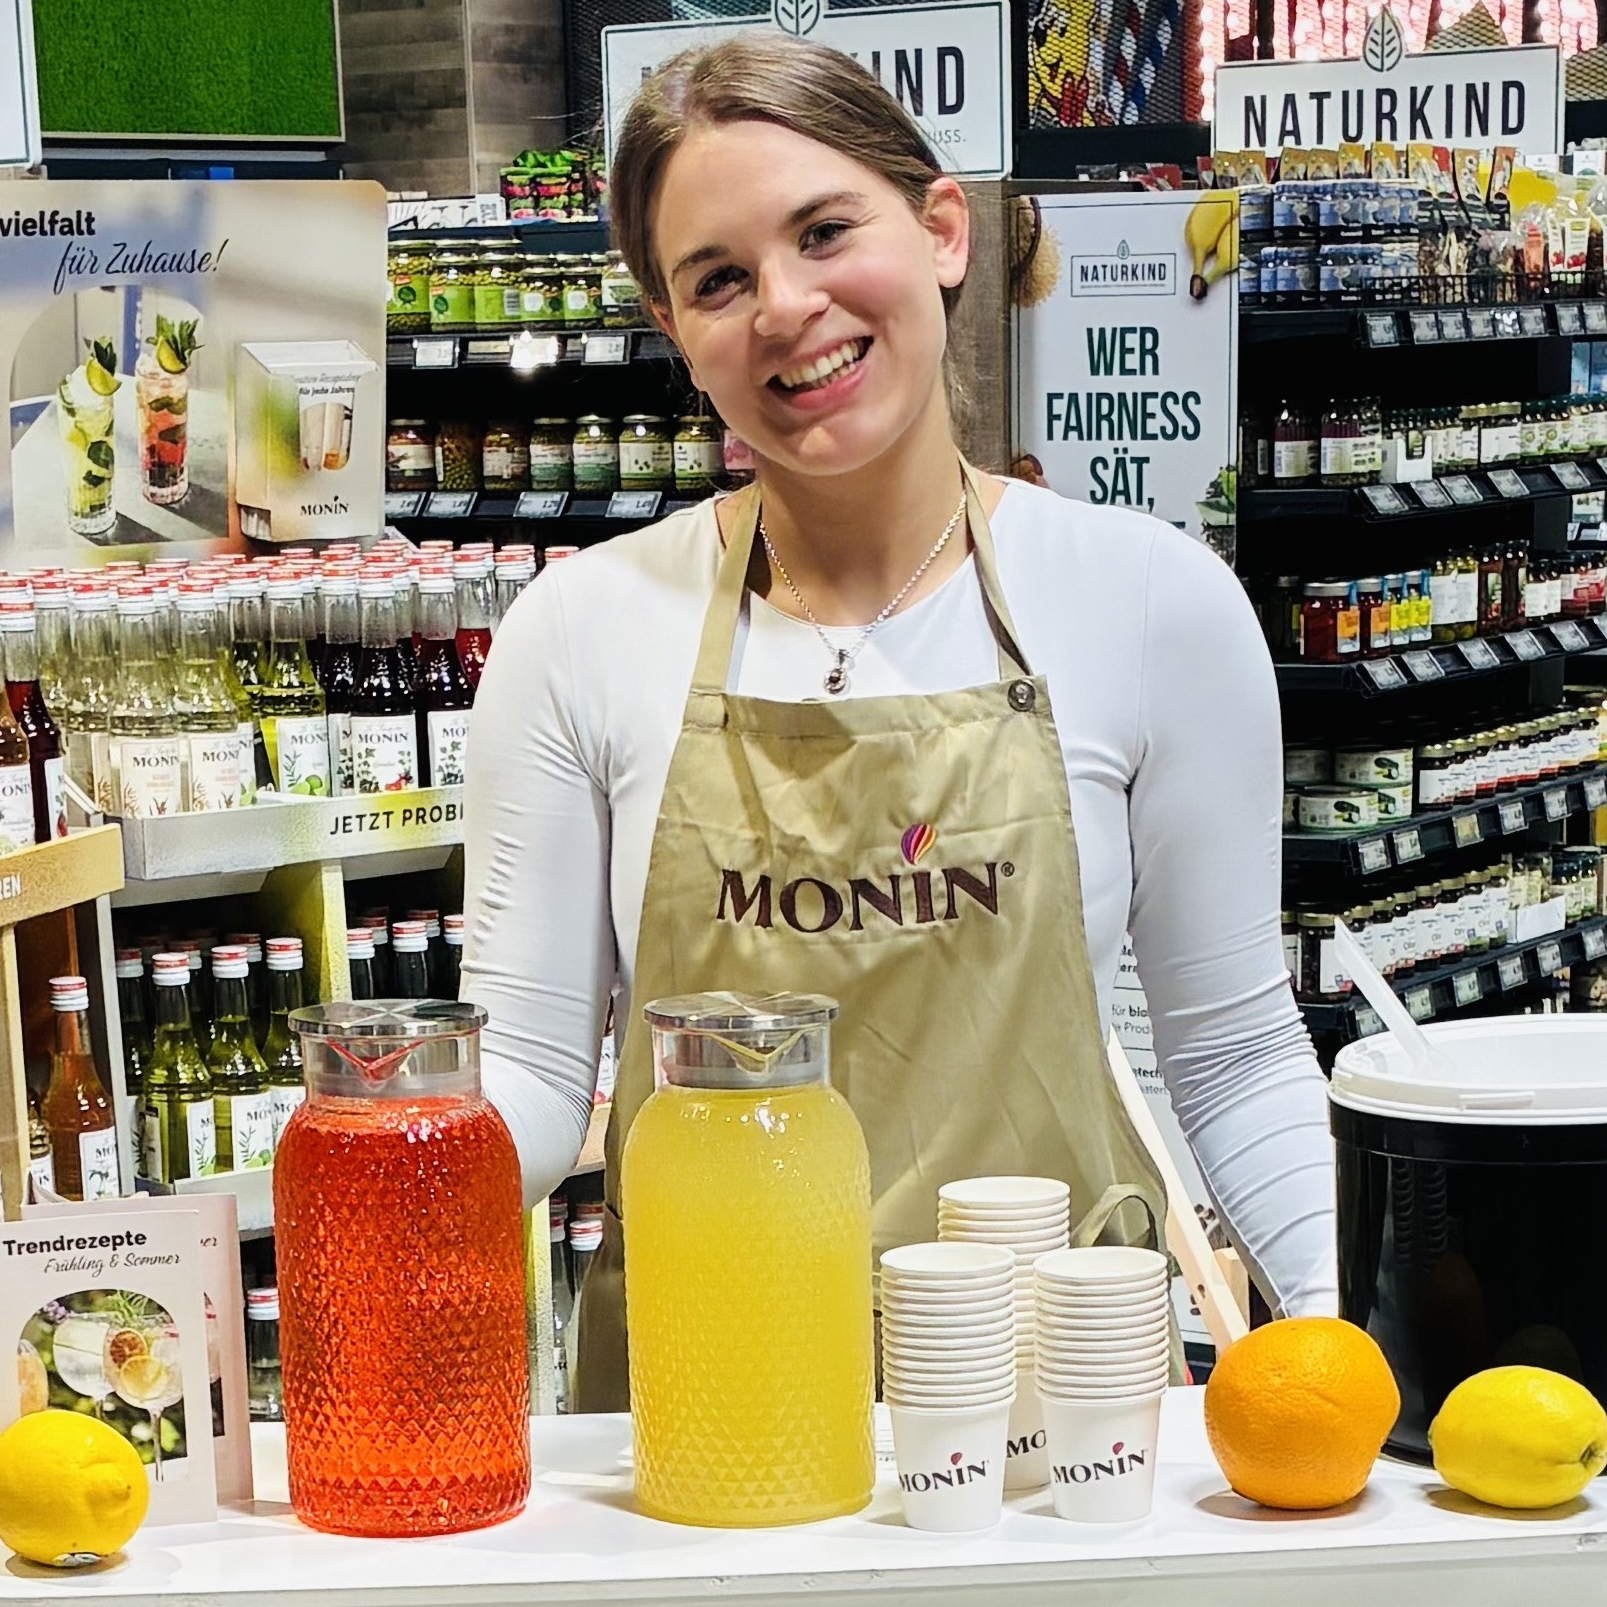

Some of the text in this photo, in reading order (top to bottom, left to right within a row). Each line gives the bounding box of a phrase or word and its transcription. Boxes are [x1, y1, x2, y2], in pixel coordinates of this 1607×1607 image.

[1243, 80, 1526, 148] NATURKIND
[0, 210, 96, 237] vielfalt
[53, 238, 230, 295] für Zuhause!
[1080, 263, 1167, 282] NATURKIND
[1086, 326, 1160, 377] WER
[1046, 391, 1202, 441] FAIRNESS
[1089, 447, 1155, 513] SÄT,
[300, 500, 350, 516] MONIN
[357, 733, 410, 744] MONIN
[330, 810, 395, 836] JETZT
[3, 1230, 148, 1256] Trendrezepte
[44, 1252, 181, 1278] Frühling & Sommer
[899, 1460, 988, 1494] MONIN
[1052, 1449, 1146, 1484] MONIN
